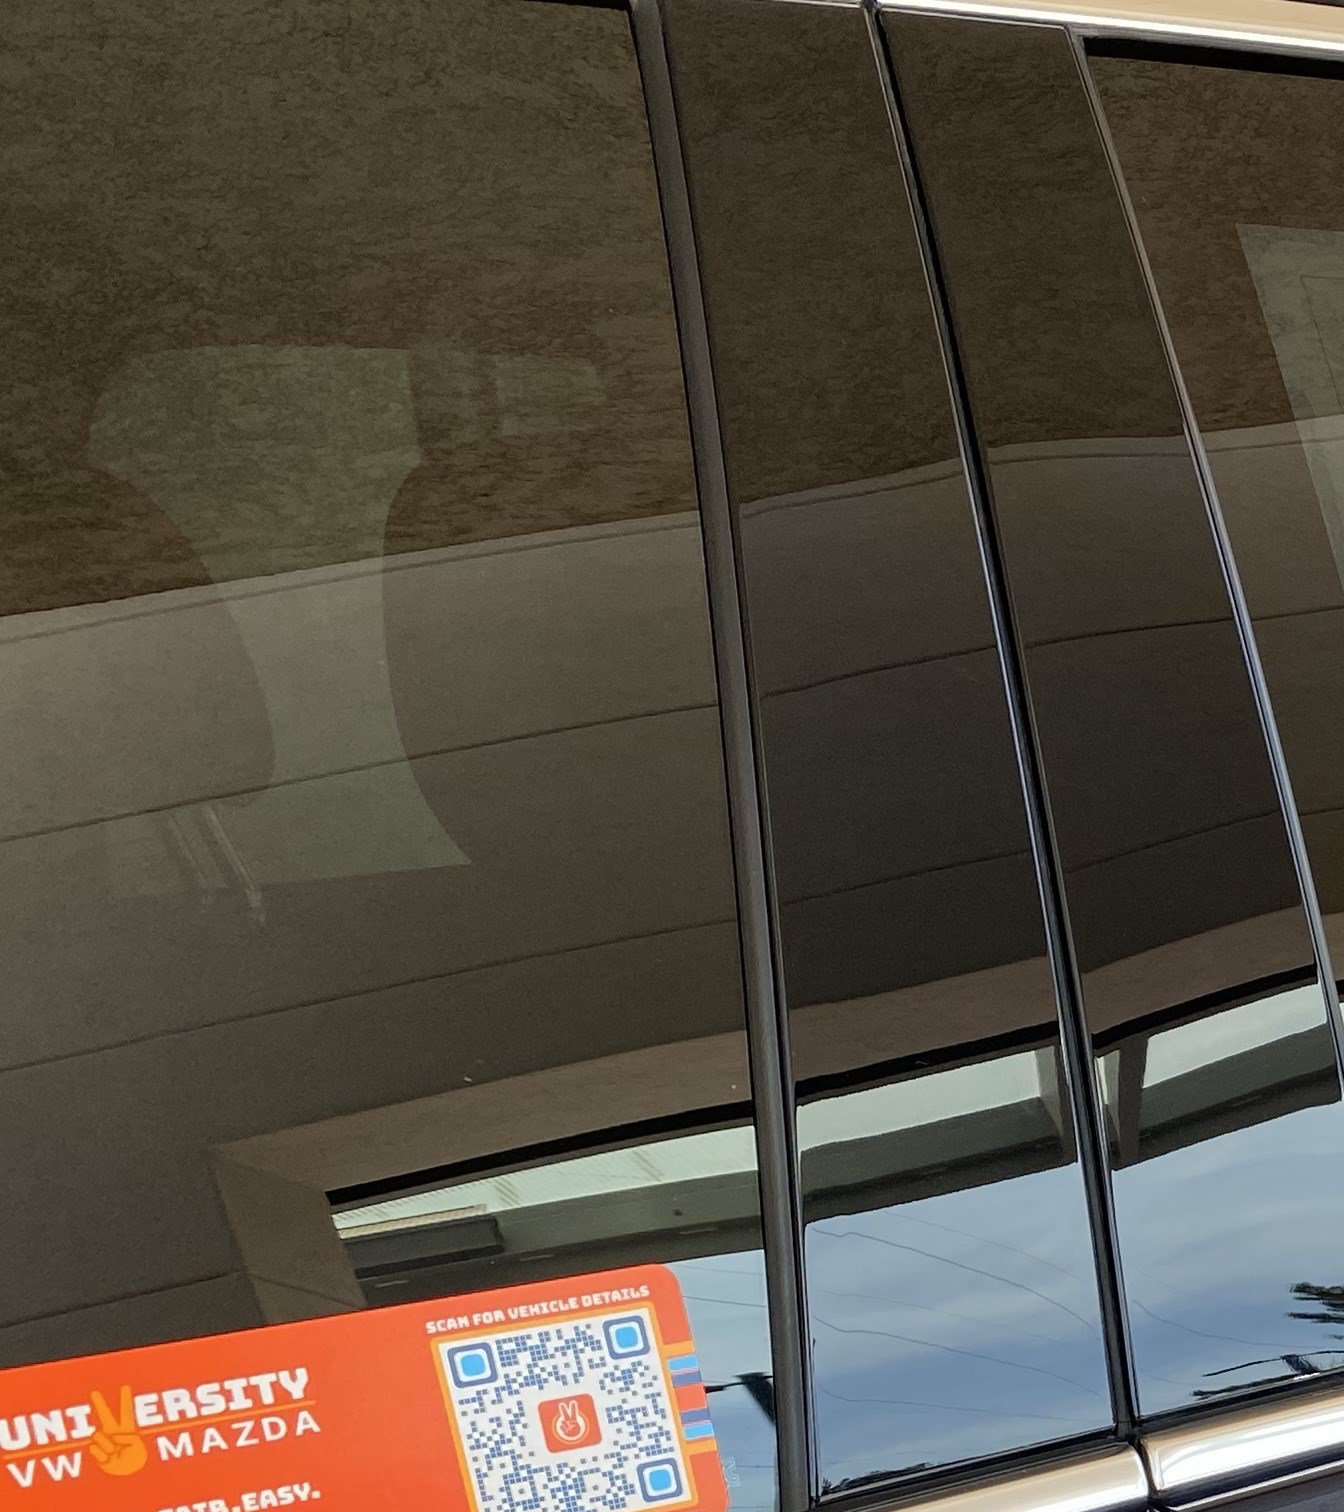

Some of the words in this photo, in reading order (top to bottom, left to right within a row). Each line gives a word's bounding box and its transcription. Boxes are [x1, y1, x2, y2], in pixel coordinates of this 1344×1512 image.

[425, 1314, 471, 1334] SCAN
[472, 1310, 506, 1326] FOR
[507, 1294, 580, 1320] VEHICLE
[582, 1285, 651, 1308] DETAILS
[0, 1367, 309, 1451] UNIVERSITY
[6, 1451, 82, 1488] VW
[156, 1410, 321, 1461] MAZDA
